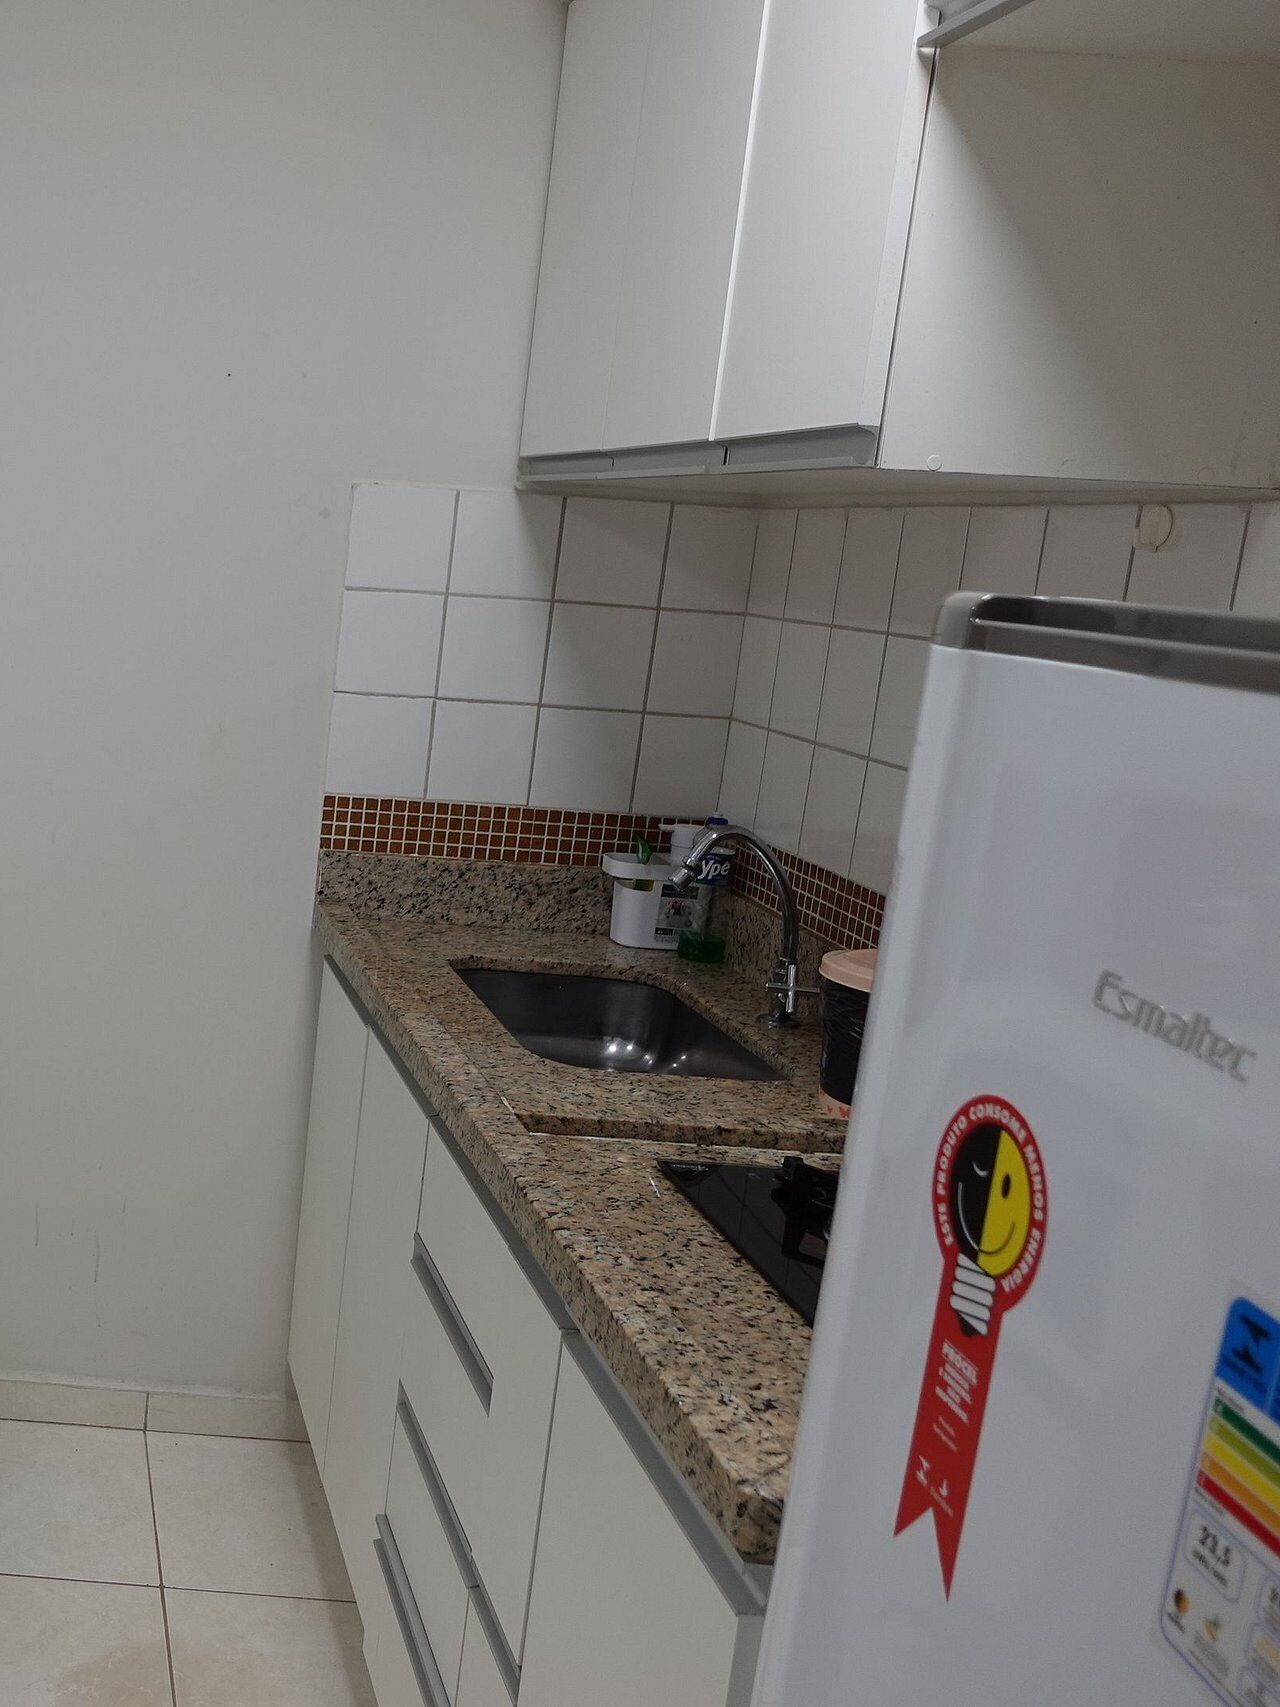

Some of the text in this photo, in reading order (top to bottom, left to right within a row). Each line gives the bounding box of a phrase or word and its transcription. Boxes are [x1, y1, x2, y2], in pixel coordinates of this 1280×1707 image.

[1093, 970, 1258, 1083] Esmaltec
[936, 1102, 1045, 1294] ESTE PRODUTO CONSOME MENOS ENERGIA
